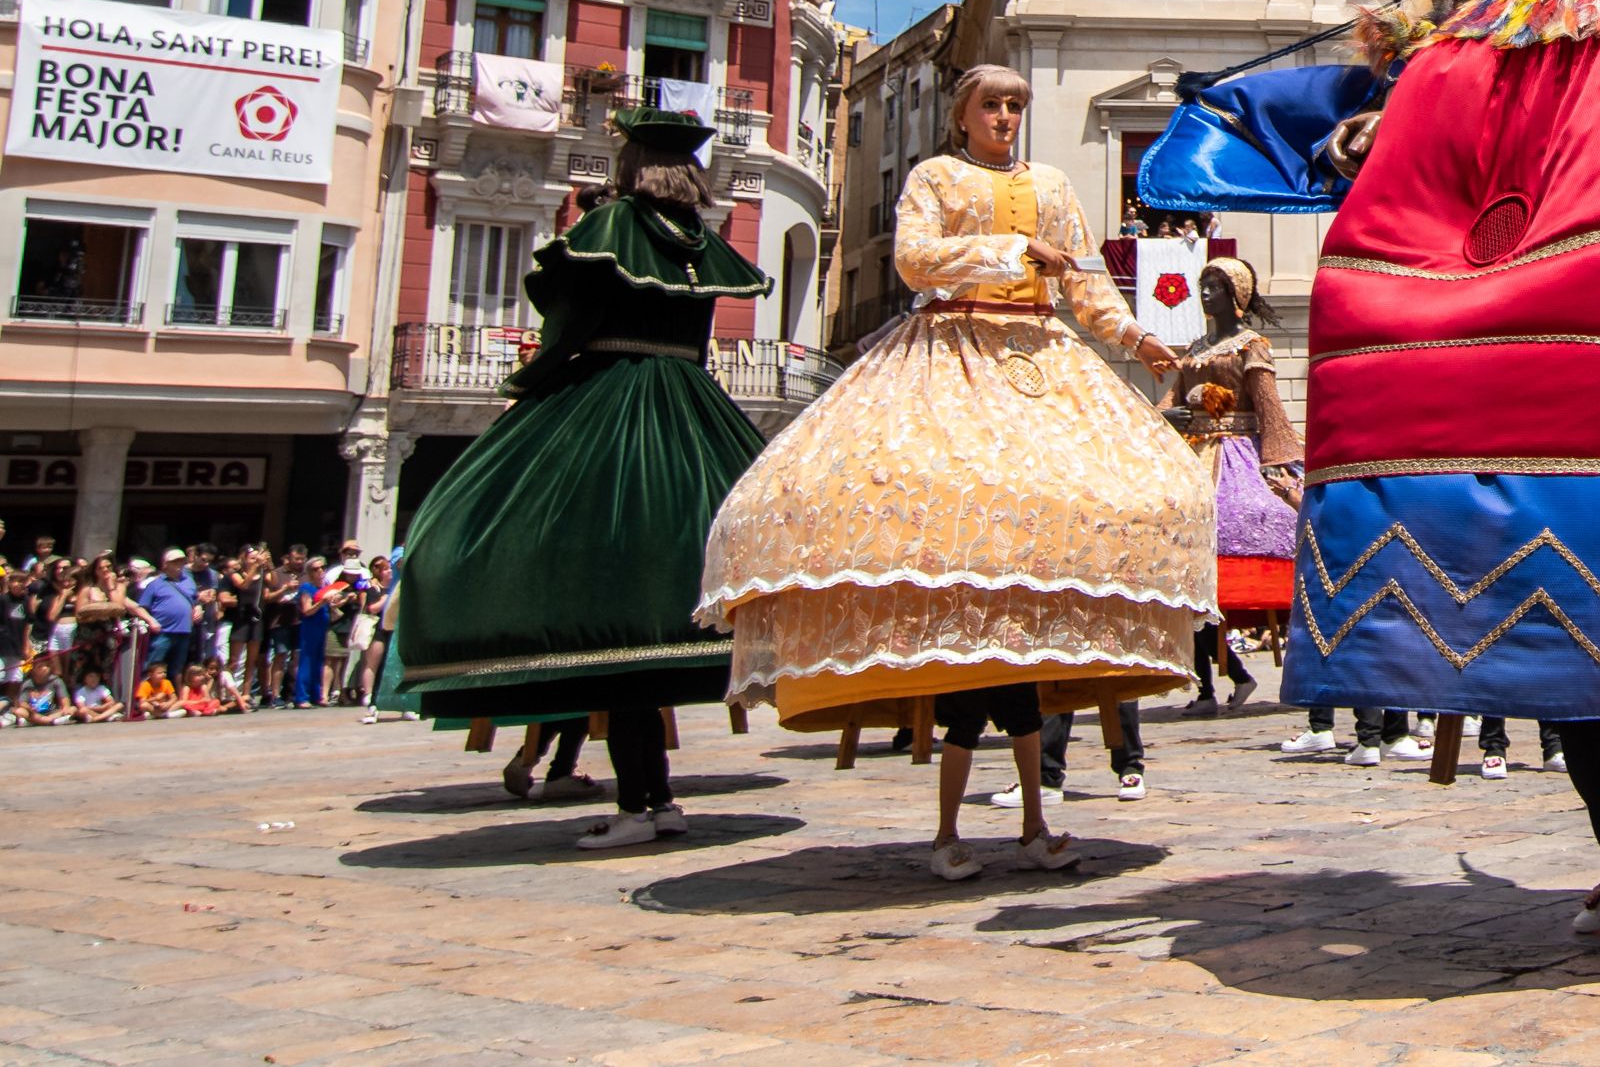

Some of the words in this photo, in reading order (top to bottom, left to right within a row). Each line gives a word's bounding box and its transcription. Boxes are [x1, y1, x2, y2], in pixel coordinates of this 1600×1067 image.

[43, 15, 142, 52] HOLA,
[150, 30, 234, 58] SANT
[242, 40, 322, 69] PERE!
[38, 58, 156, 97] BONA
[34, 86, 151, 123] FESTA
[31, 113, 184, 153] MAJOR!
[7, 459, 250, 487] BABERA
